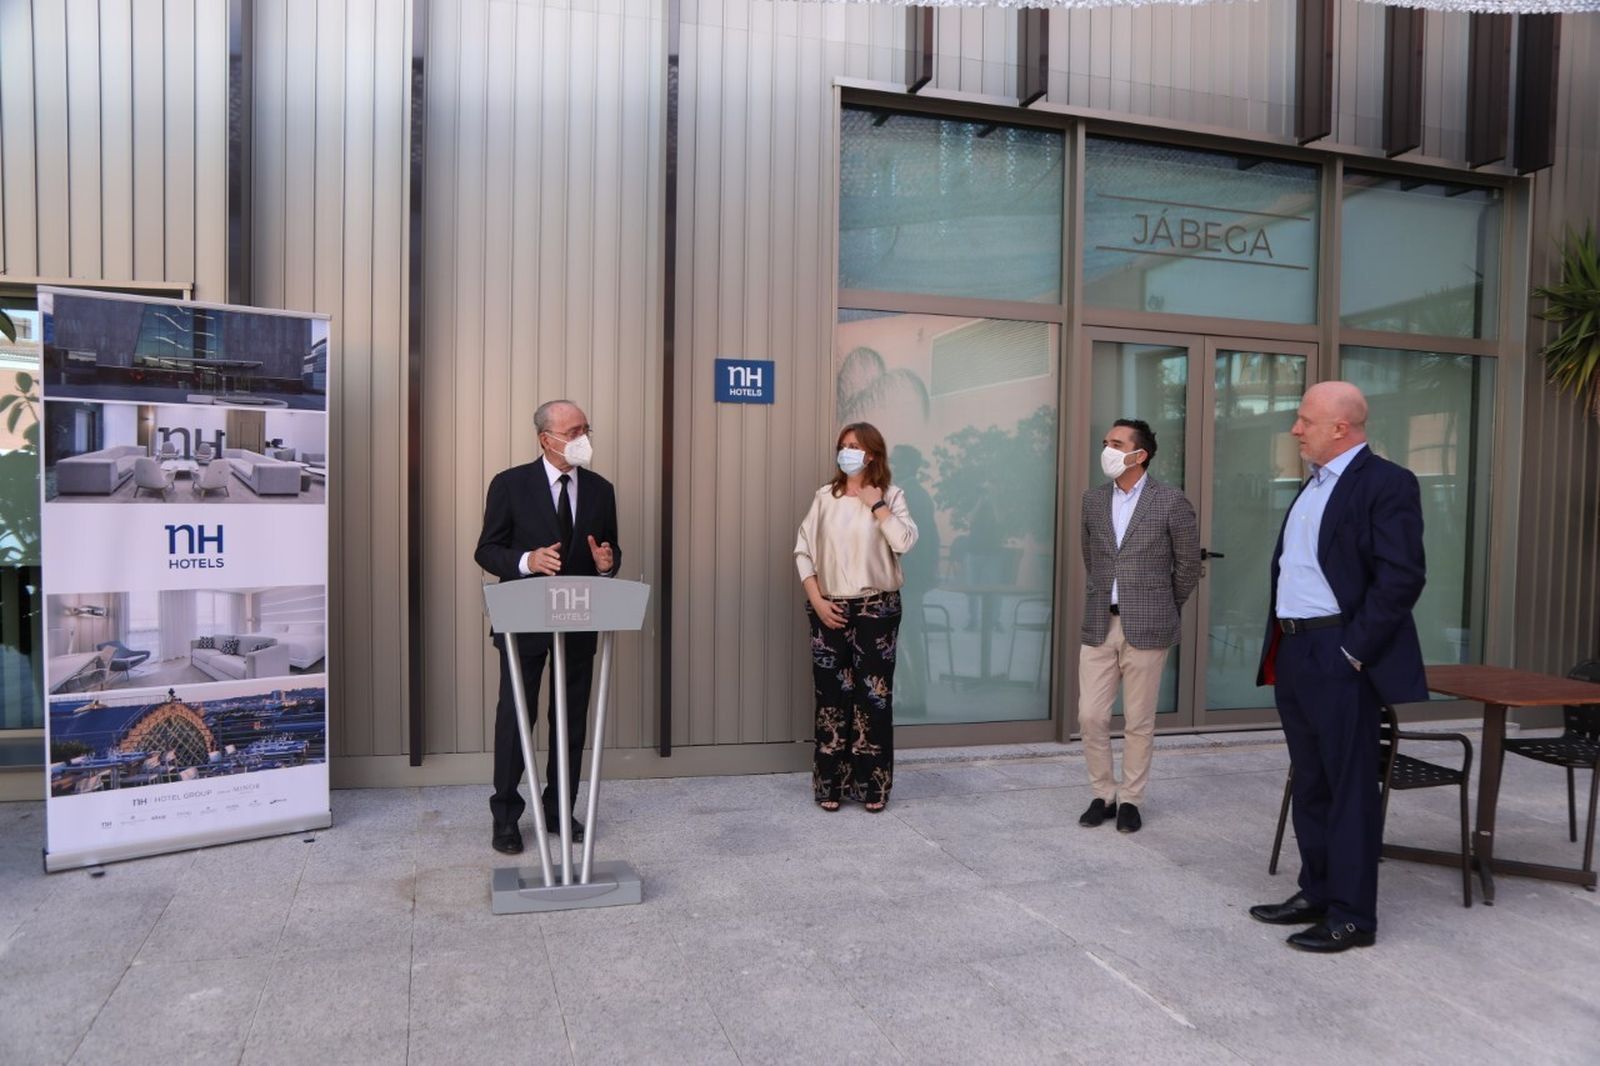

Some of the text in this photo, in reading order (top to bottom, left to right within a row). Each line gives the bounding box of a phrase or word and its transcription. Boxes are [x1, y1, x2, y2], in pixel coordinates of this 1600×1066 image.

[1132, 207, 1273, 259] JÁBEGA
[729, 388, 762, 397] HOTELS
[168, 557, 225, 569] HOTELS
[551, 612, 590, 621] HOTELS
[154, 794, 181, 803] HOTEL
[183, 789, 213, 800] GROUP
